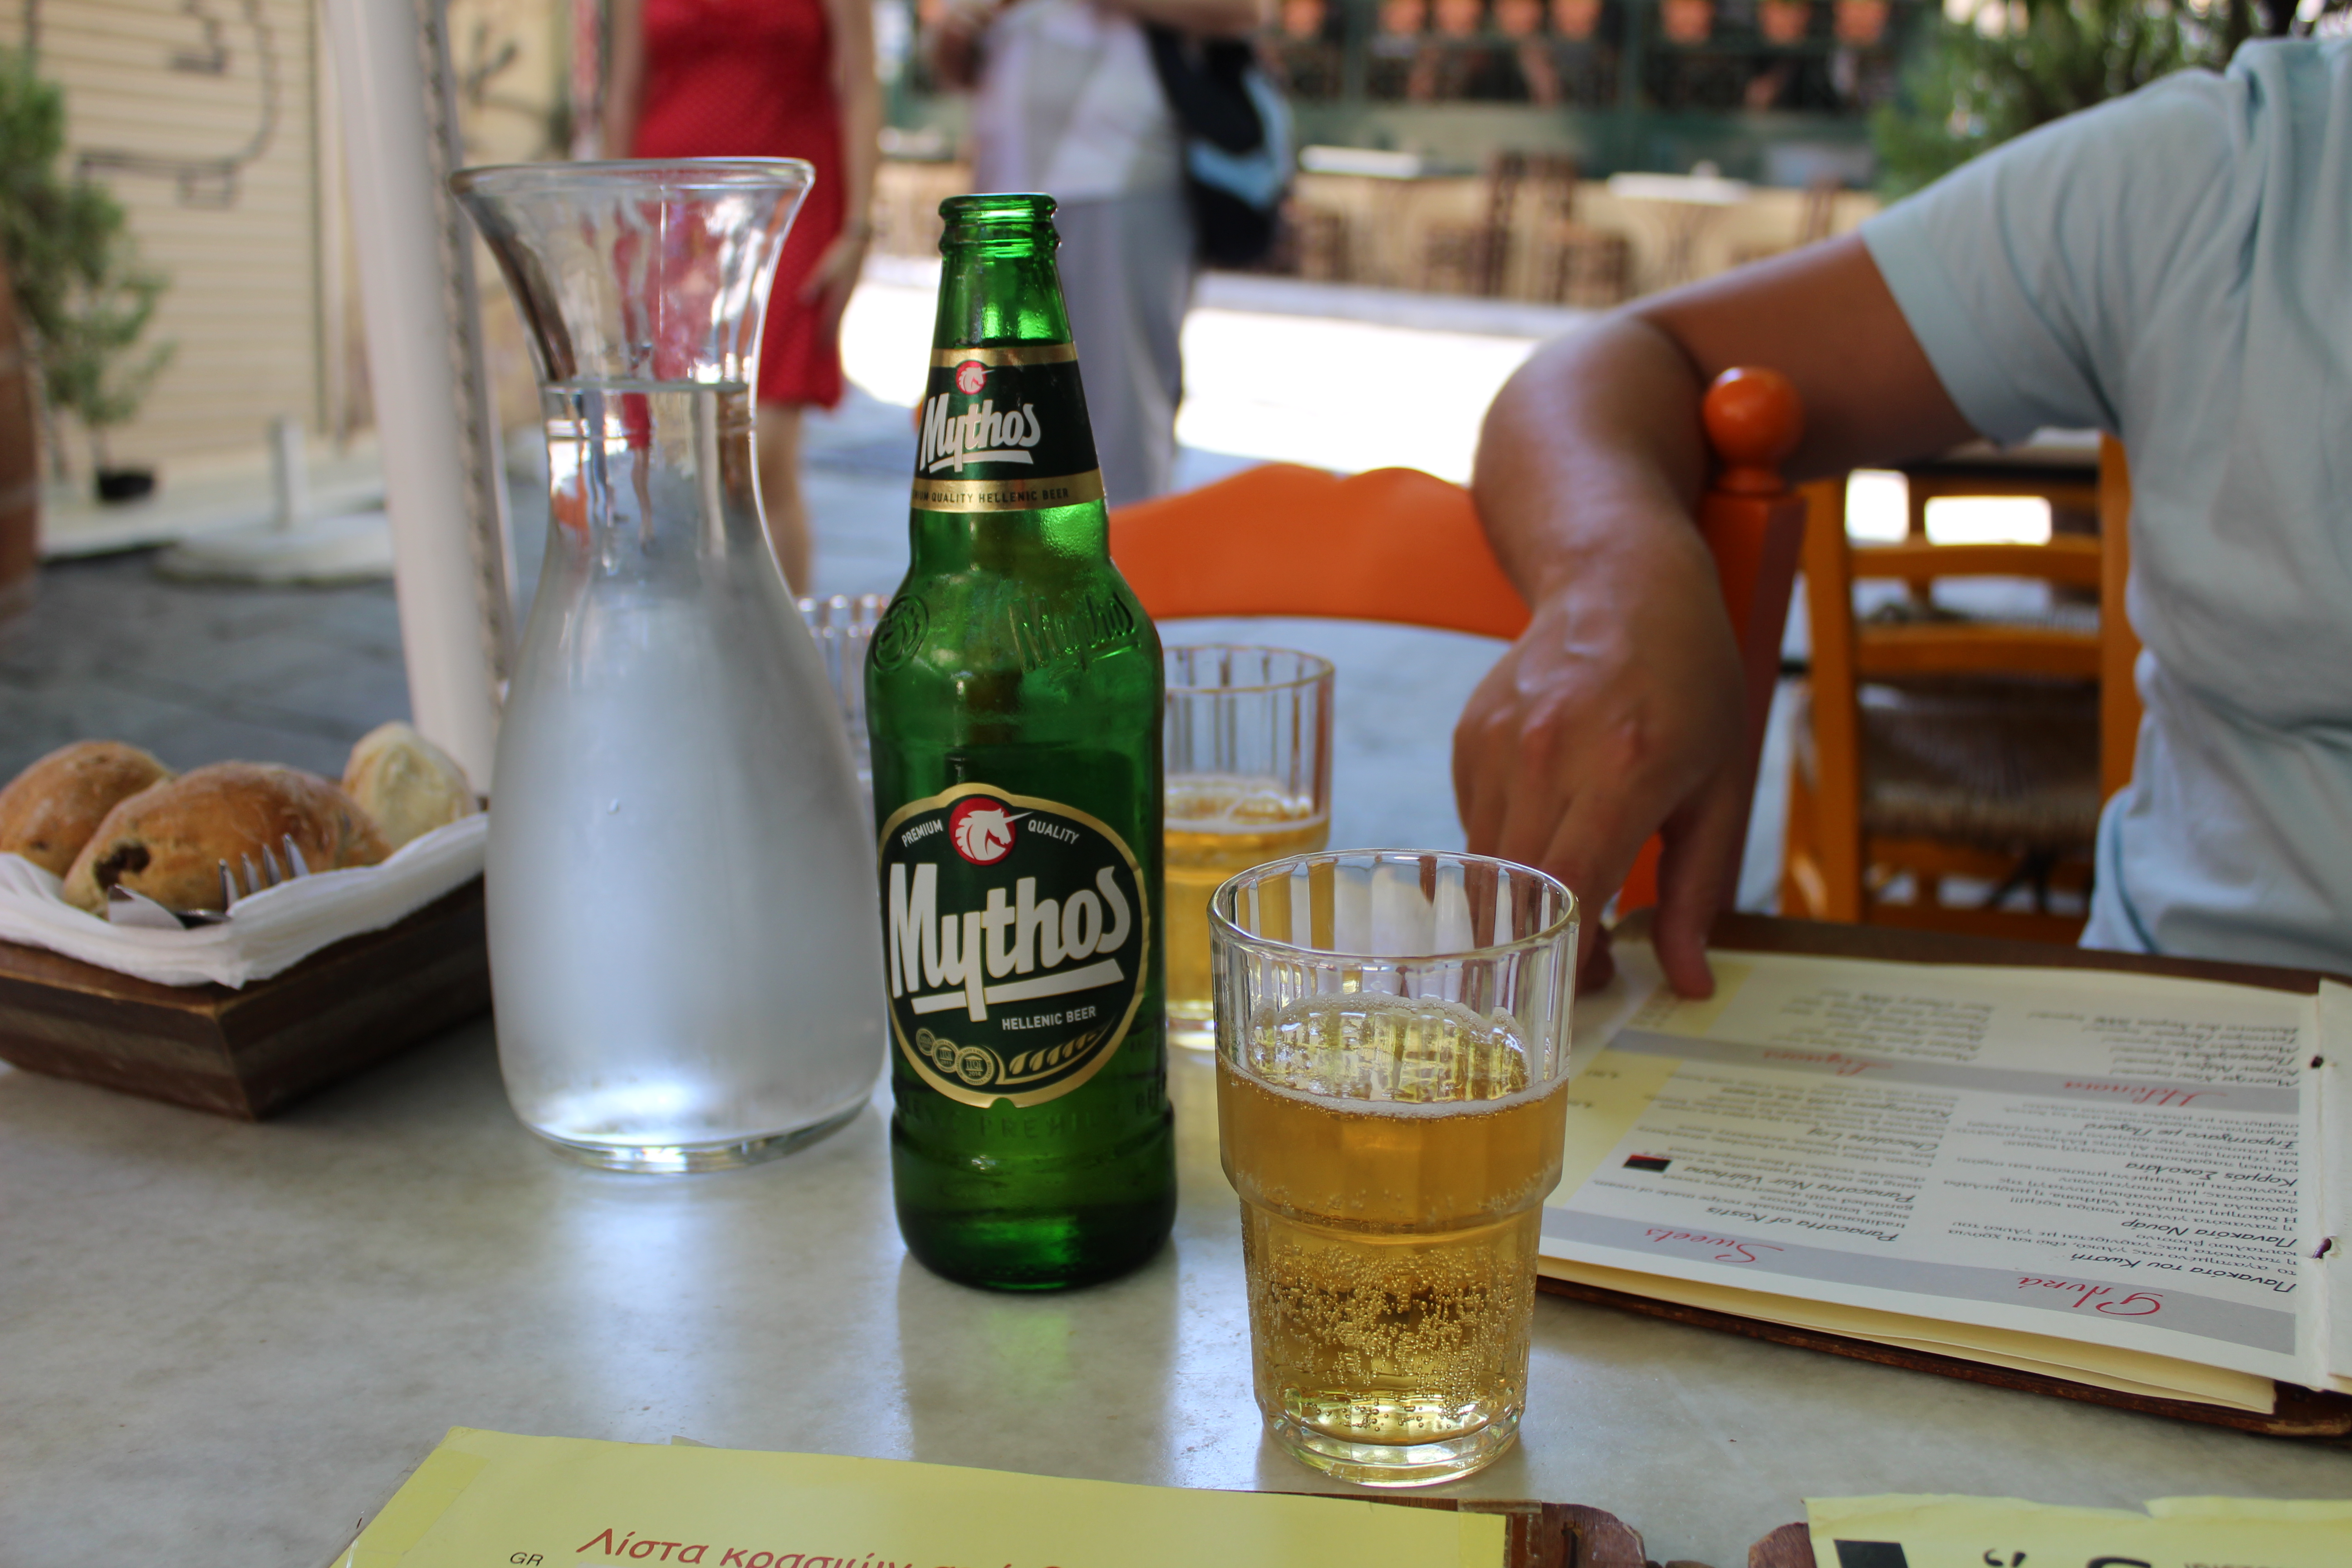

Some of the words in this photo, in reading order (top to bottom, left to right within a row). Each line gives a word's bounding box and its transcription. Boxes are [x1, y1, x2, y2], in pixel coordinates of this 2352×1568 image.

[920, 392, 1041, 472] Mythos
[931, 492, 973, 503] QUALITY
[979, 491, 1037, 503] HELLENIC
[1042, 488, 1068, 499] BEER
[902, 819, 943, 847] PREMIUM
[1028, 819, 1079, 845] QUALITY
[889, 863, 1131, 1022] Mythos
[1002, 1013, 1063, 1031] HELLENIC
[1066, 1006, 1097, 1024] BEER
[1847, 1134, 1940, 1153] Chocolate
[1683, 1166, 1764, 1186] Valrhona
[2124, 1161, 2218, 1181] Σοκολάτα
[1768, 1179, 1814, 1191] Noir
[2223, 1172, 2298, 1188] Κορμός
[1816, 1184, 1917, 1203] Panacotta
[1705, 1207, 1768, 1223] Kostis
[1764, 1217, 1793, 1225] of
[1796, 1220, 1900, 1242] Panacotta
[2120, 1219, 2190, 1237] Νουάρ
[1646, 1228, 1784, 1263] Sweets
[2193, 1229, 2298, 1248] Πανακότα
[2132, 1249, 2164, 1258] σας
[2156, 1244, 2188, 1252] μας
[2193, 1249, 2281, 1264] πανακότα
[2208, 1243, 2298, 1257] κουταλιού
[2069, 1253, 2141, 1269] Κωστή
[2146, 1262, 2182, 1271] του
[2167, 1254, 2269, 1270] αγαπημένο
[2286, 1258, 2298, 1266] η
[2189, 1267, 2297, 1293] Πανακότα
[576, 1528, 709, 1564] Λίστα
[509, 1552, 544, 1567] GR
